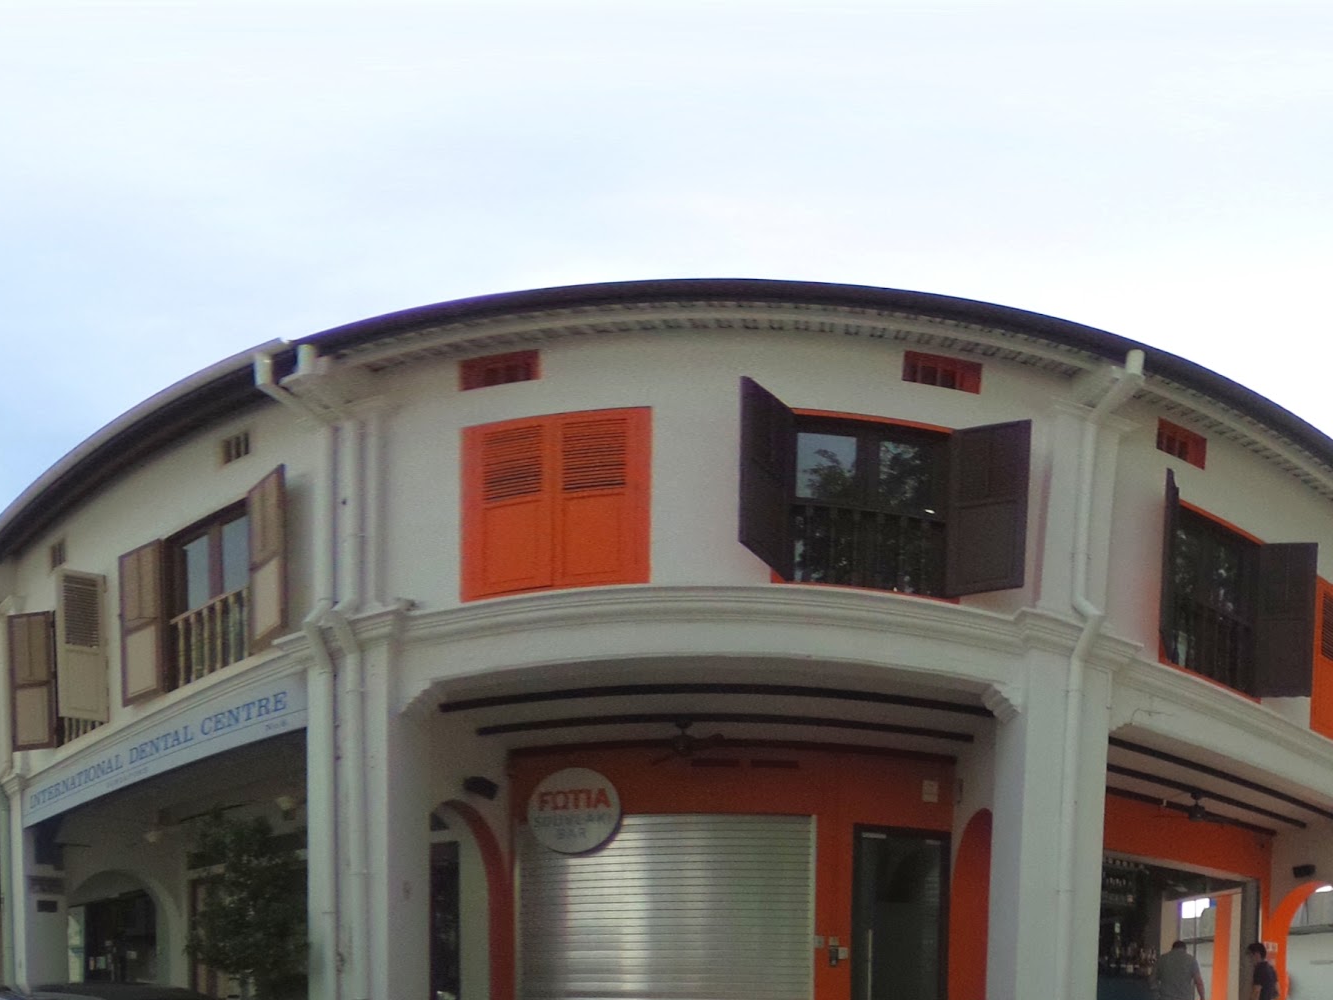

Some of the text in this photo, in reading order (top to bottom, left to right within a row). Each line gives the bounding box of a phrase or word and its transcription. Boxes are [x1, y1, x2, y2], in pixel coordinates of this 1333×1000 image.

[29, 754, 123, 809] INTERNATIONAL
[128, 732, 193, 764] DENTAL
[200, 691, 287, 736] CENTRE
